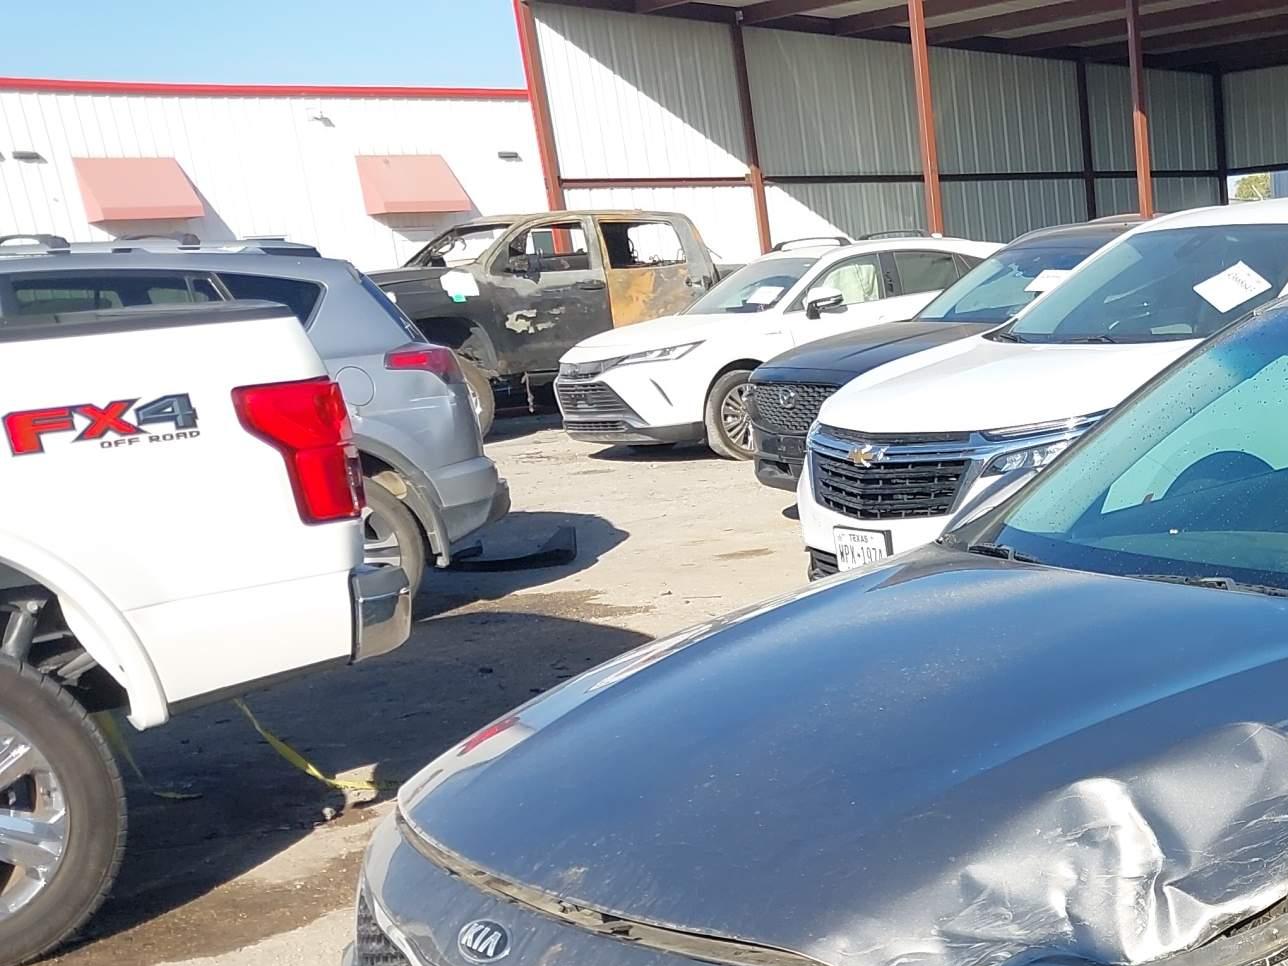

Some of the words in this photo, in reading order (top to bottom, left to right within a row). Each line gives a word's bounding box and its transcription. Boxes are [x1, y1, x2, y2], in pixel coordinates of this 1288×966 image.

[1, 392, 199, 457] FX4
[99, 437, 141, 449] OFF
[149, 430, 201, 443] ROAD
[848, 533, 869, 543] TEXAS
[461, 922, 502, 957] KIA
